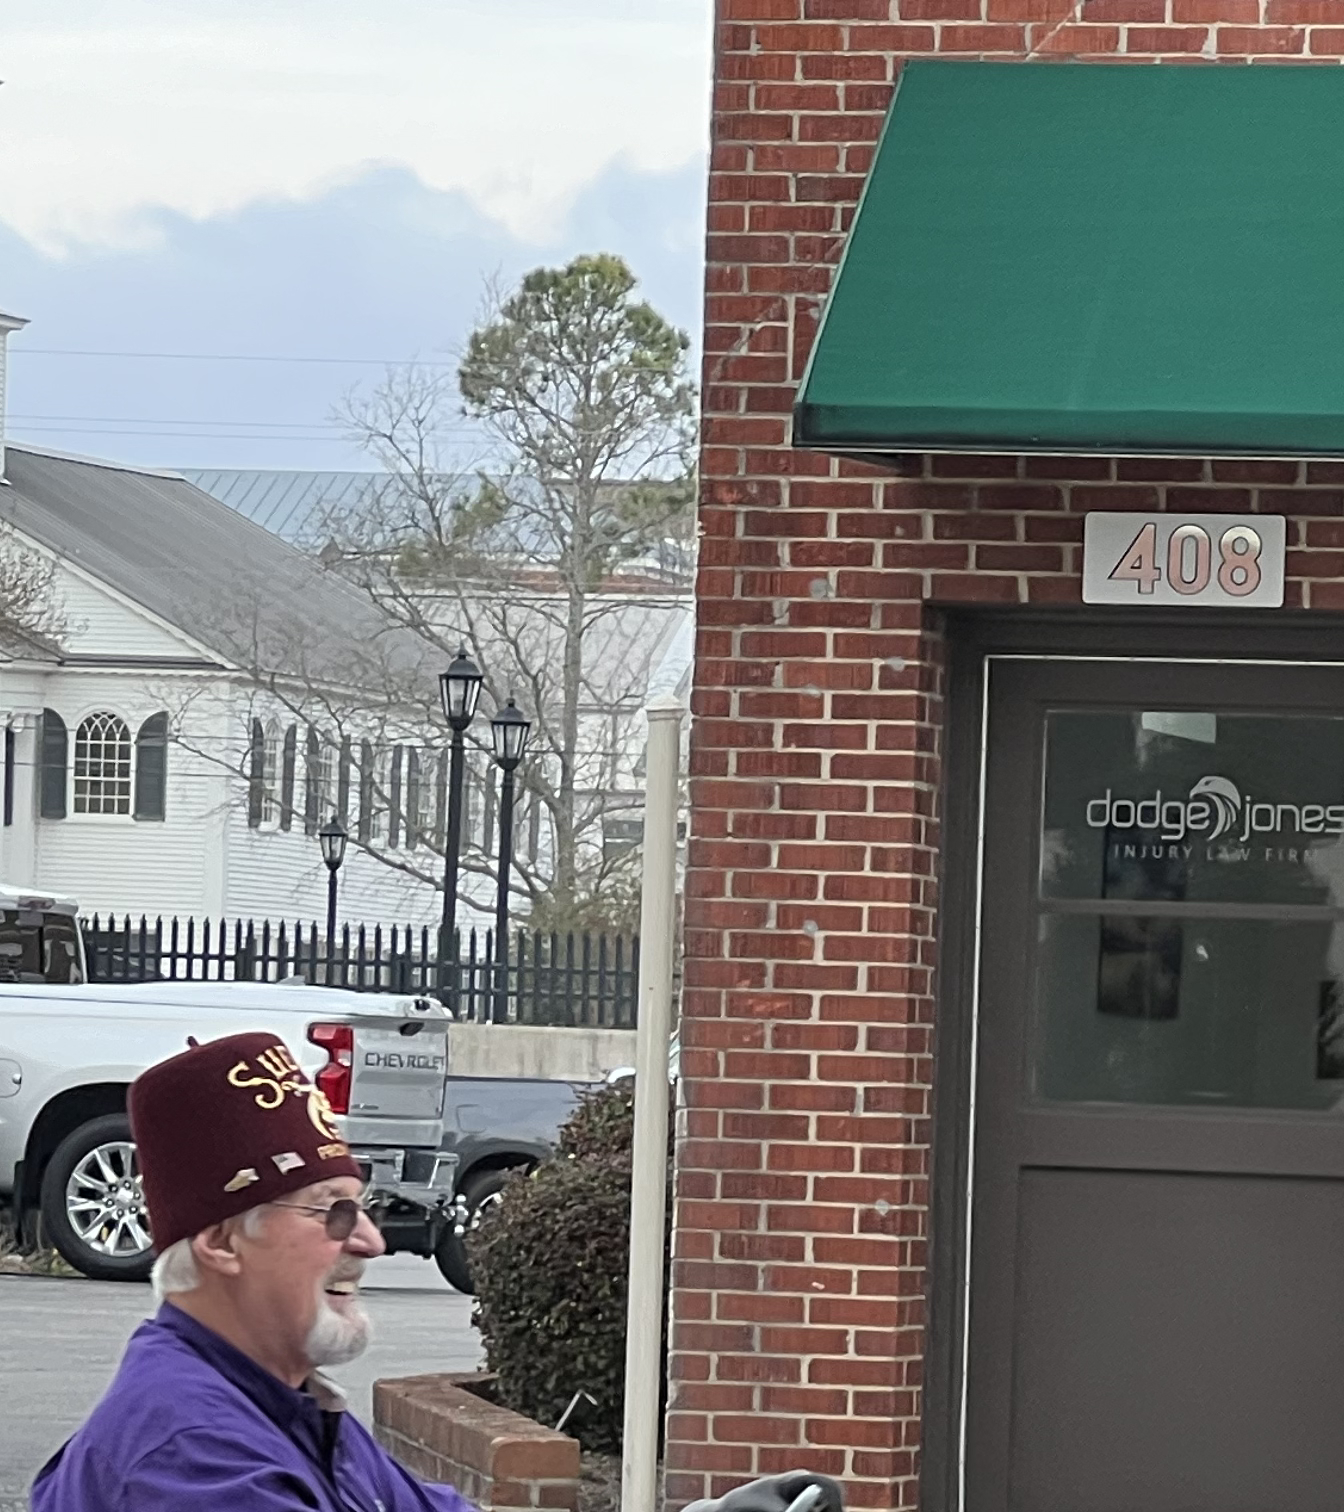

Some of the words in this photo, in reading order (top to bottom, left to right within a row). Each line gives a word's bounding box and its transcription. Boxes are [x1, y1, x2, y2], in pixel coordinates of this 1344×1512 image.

[1107, 522, 1263, 596] 408
[1086, 789, 1211, 841] dodge
[1113, 843, 1192, 861] INJURY
[1206, 845, 1250, 863] LAW
[364, 1052, 445, 1071] CHEVROLET
